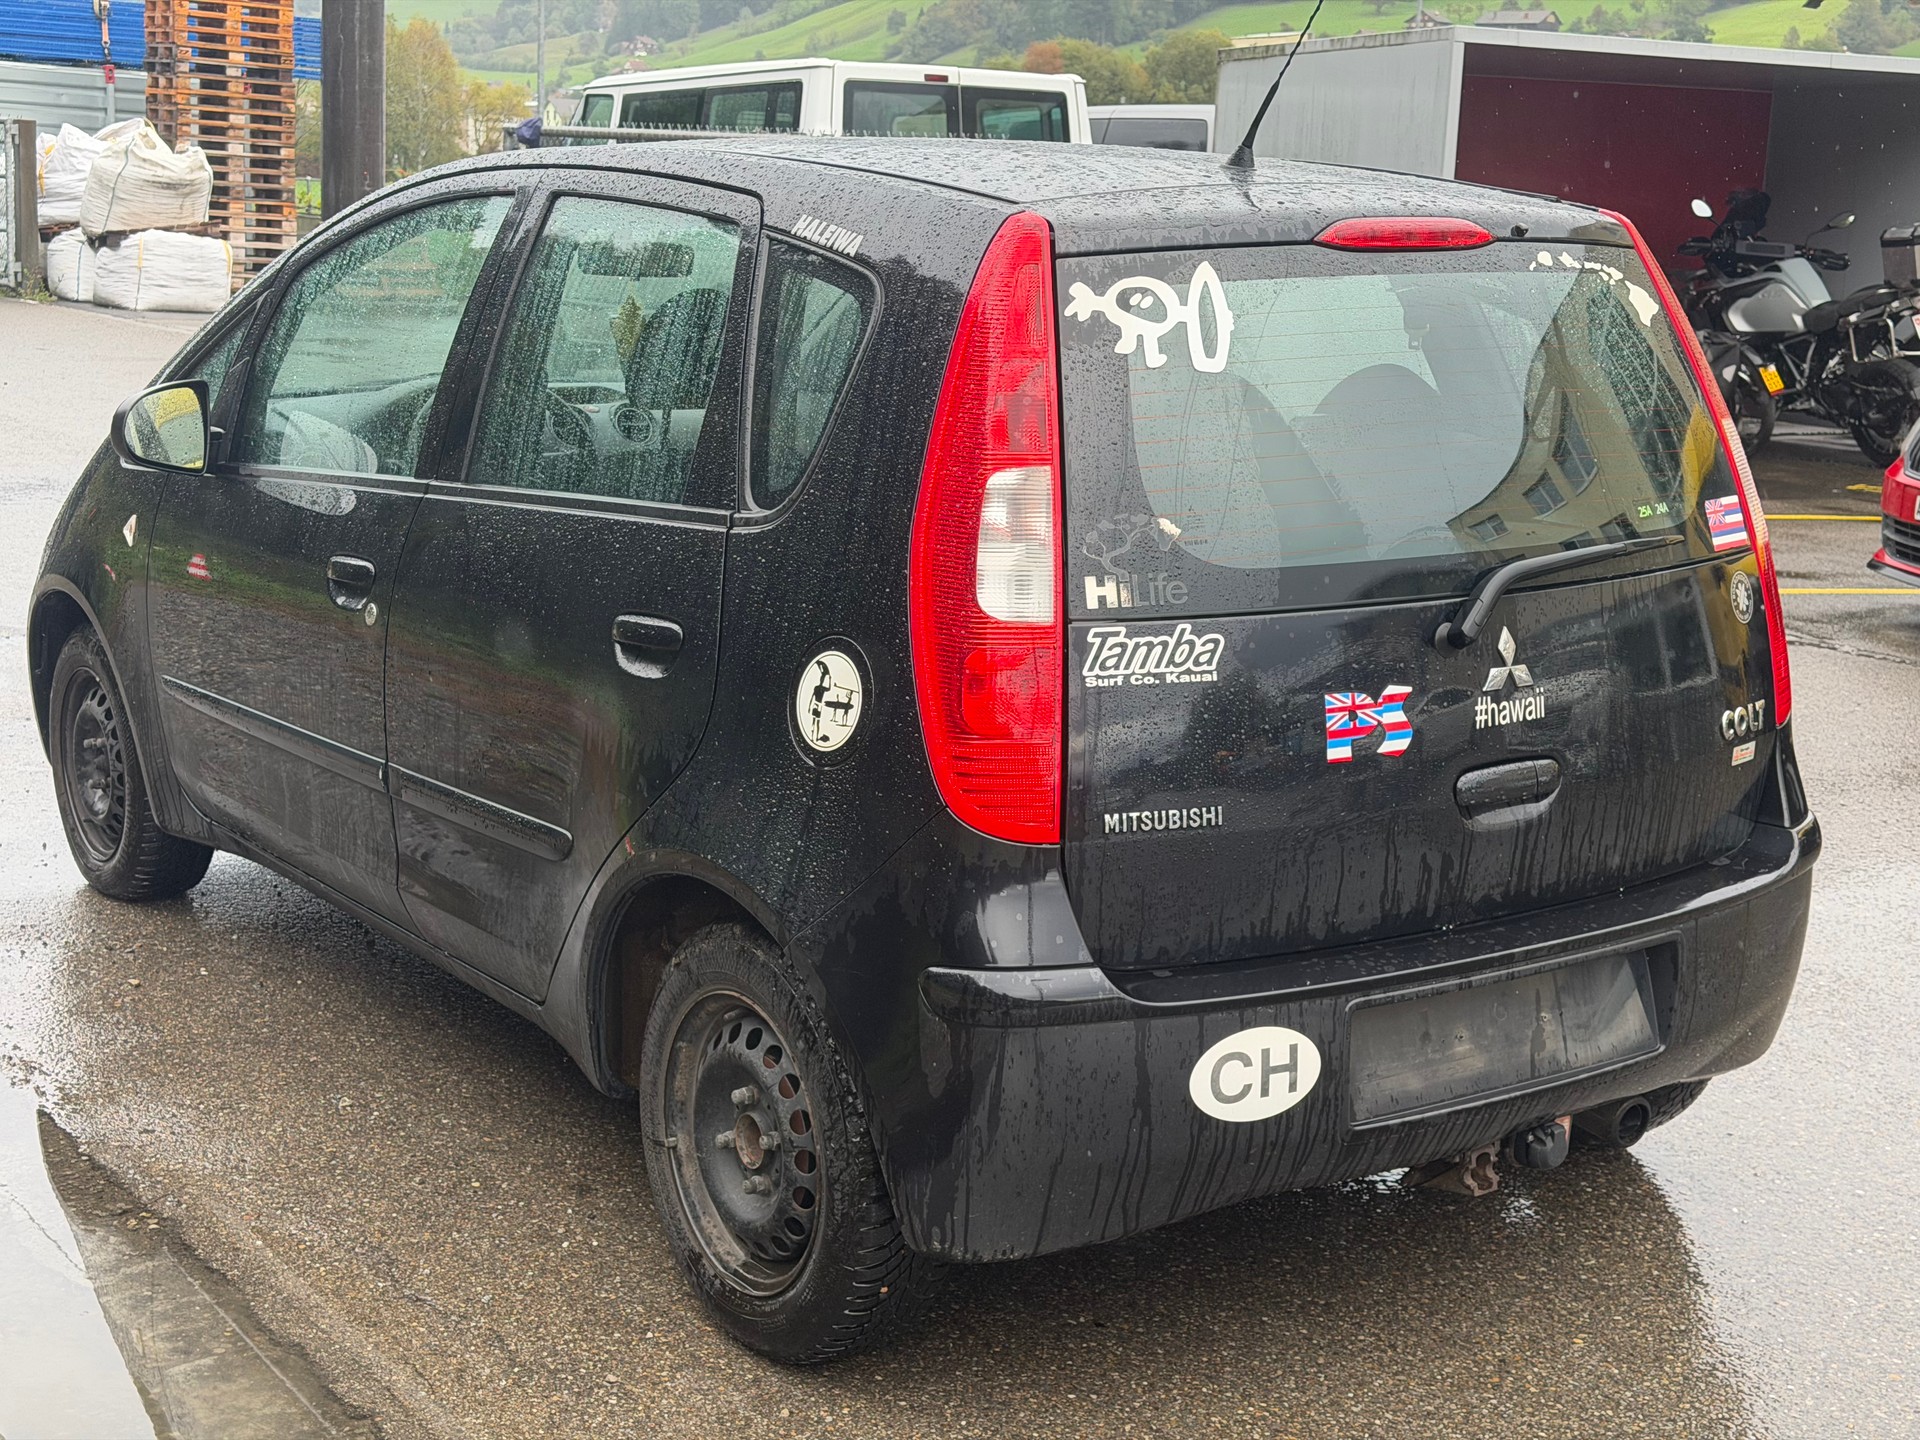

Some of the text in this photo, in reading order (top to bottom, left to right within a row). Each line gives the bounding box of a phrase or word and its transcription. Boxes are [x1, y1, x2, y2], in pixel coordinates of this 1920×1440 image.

[790, 213, 864, 258] HALEIWA
[1082, 623, 1226, 677] Tamba
[1085, 671, 1218, 688] Surf Co. Kauai
[1475, 687, 1545, 730] #hawaii
[1721, 698, 1766, 741] COLT
[1104, 806, 1223, 834] MITSUBISHI
[1210, 1043, 1298, 1104] CH
